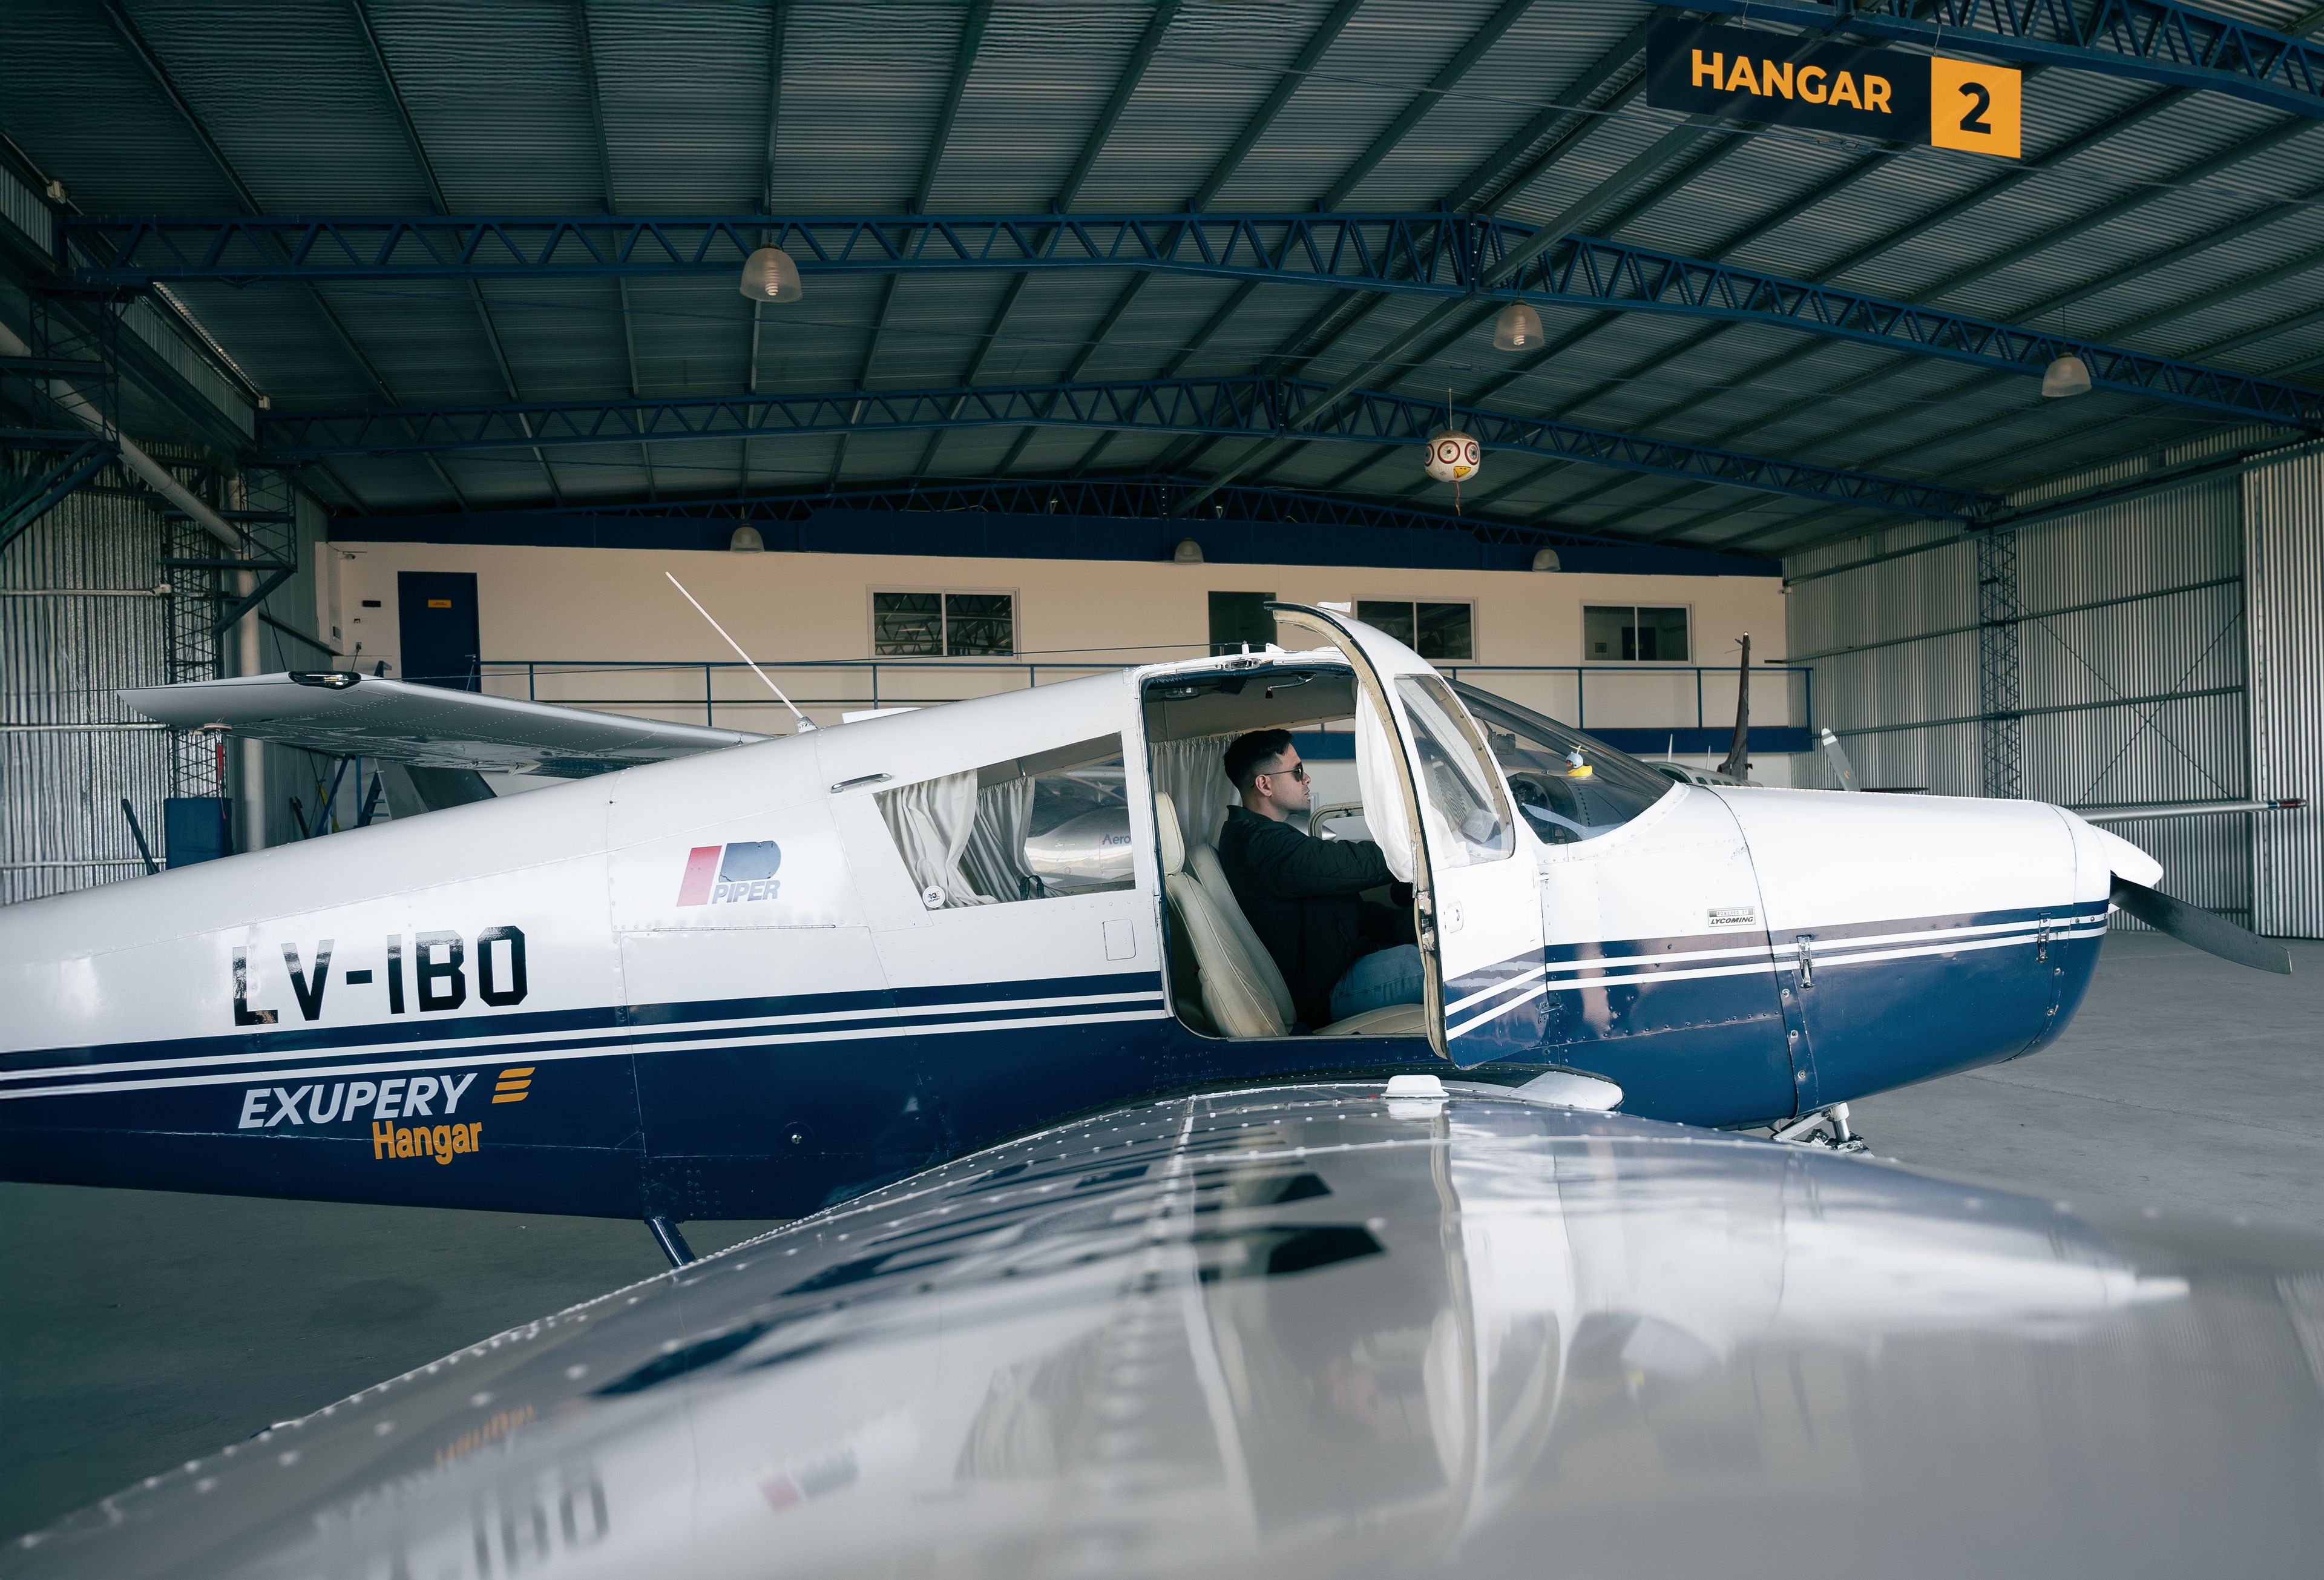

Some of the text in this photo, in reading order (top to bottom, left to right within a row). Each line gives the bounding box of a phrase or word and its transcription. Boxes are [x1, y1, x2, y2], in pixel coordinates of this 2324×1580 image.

[1692, 48, 1992, 135] HANGAR 2
[1101, 833, 1131, 845] Aero
[711, 880, 781, 904] PIPER
[1710, 917, 1754, 925] LYCOMING
[232, 925, 528, 1027] LV-IBO
[238, 1073, 478, 1129] EXUPERY
[372, 1121, 483, 1165] Hangar
